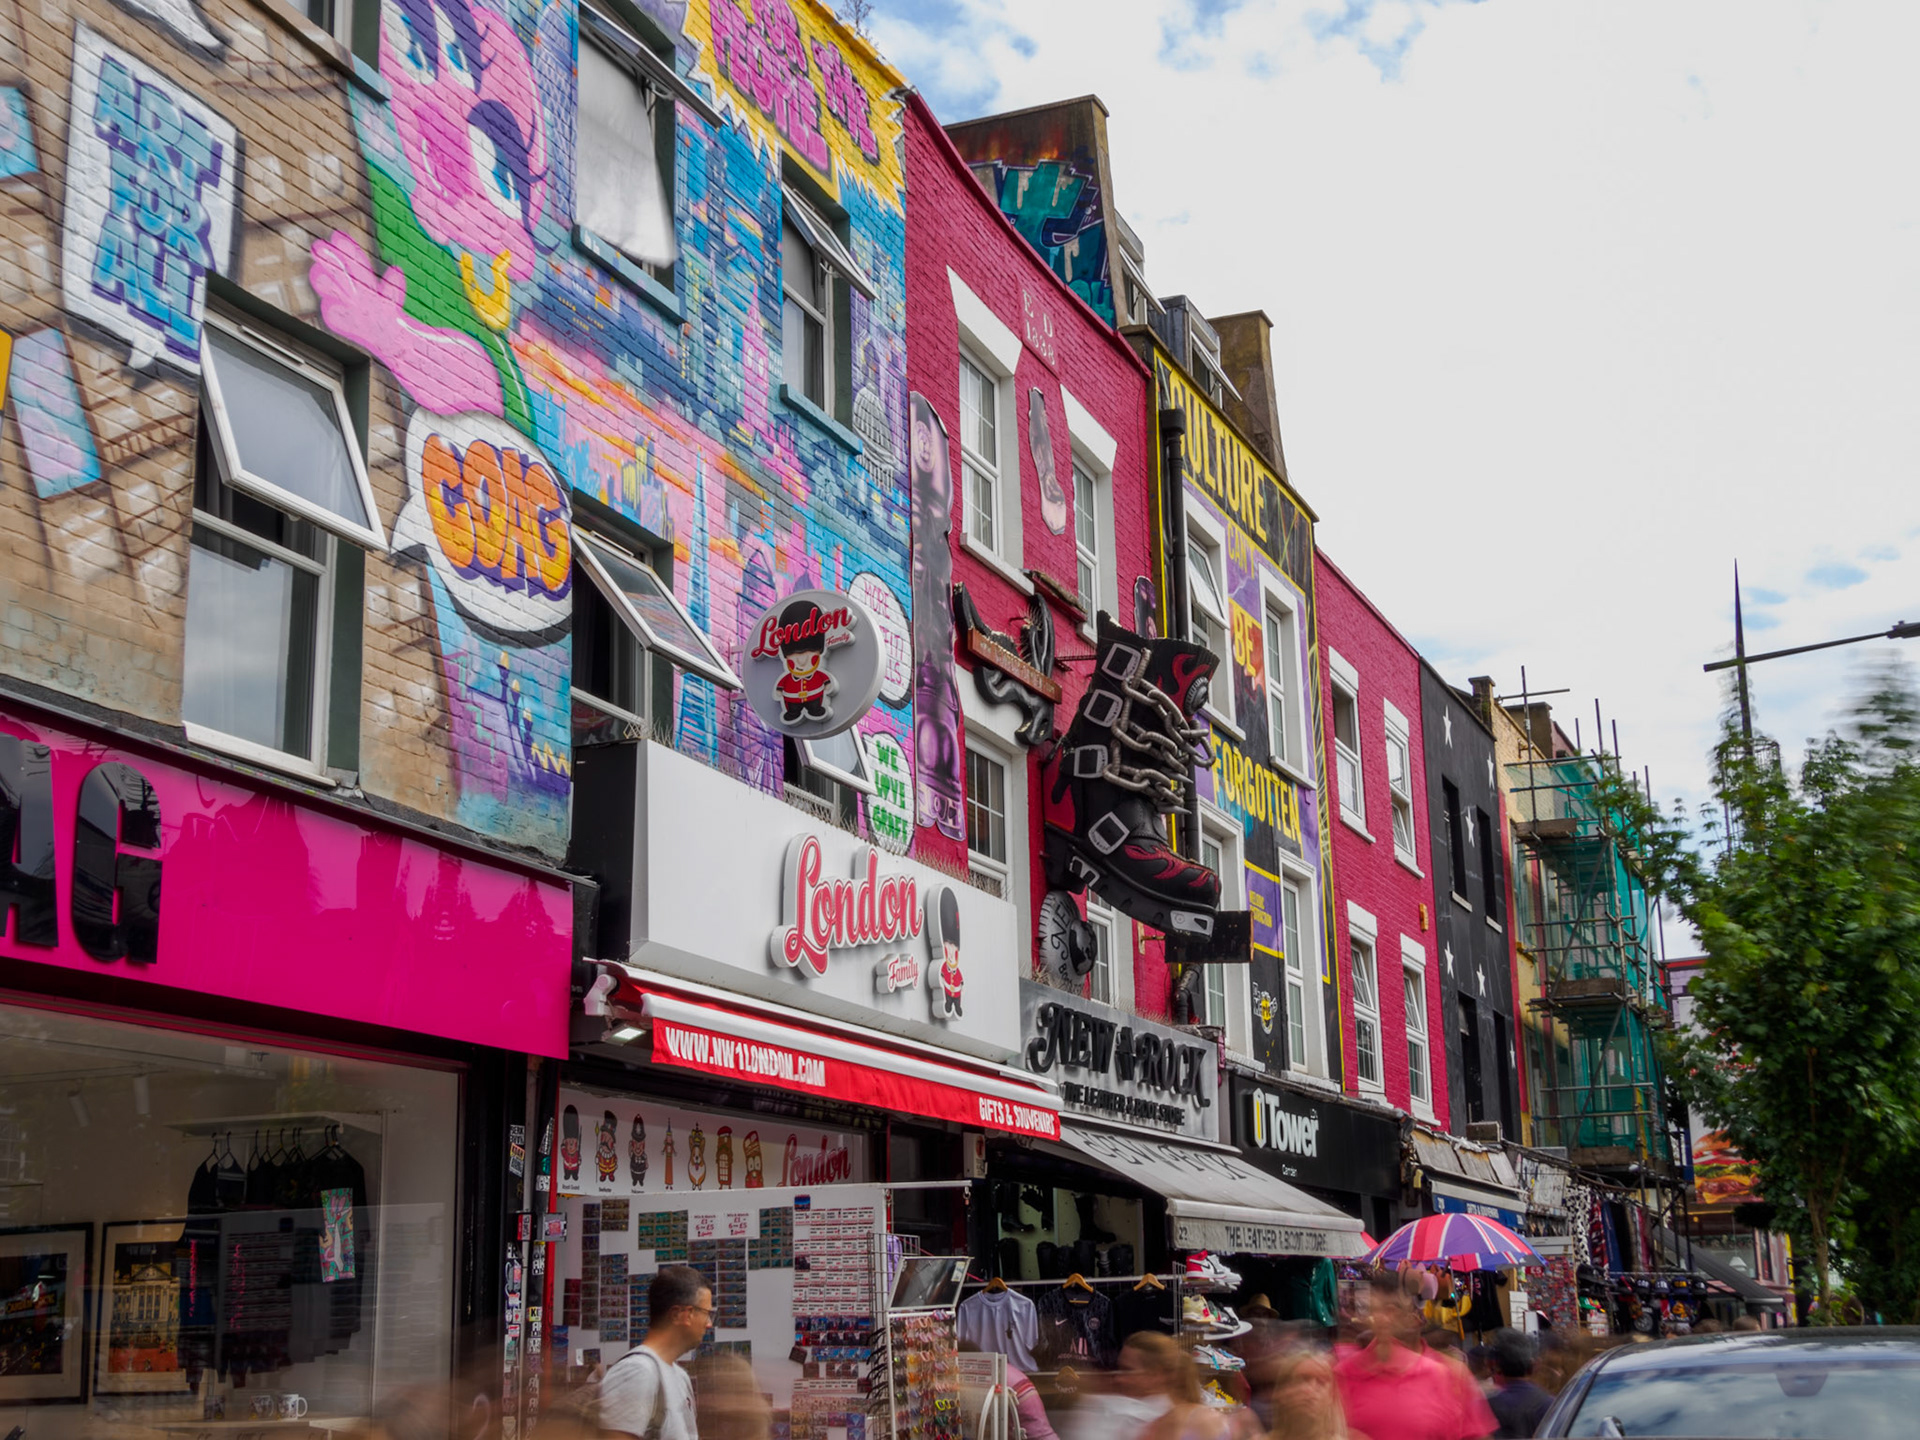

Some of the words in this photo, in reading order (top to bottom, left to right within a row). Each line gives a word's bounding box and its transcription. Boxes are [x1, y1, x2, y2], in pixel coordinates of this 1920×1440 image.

[95, 52, 222, 200] ART
[811, 36, 879, 164] THE
[110, 147, 216, 269] FOR
[91, 214, 205, 362] ALL
[1170, 368, 1268, 543] CULTURE
[751, 606, 852, 658] London
[825, 632, 851, 647] Family
[1231, 604, 1257, 677] BE
[874, 769, 906, 809] LOVE
[876, 739, 899, 773] WE
[1211, 731, 1303, 846] FORGOTTEN
[783, 834, 923, 975] London
[887, 954, 919, 992] Family
[1028, 1002, 1117, 1074] NEW
[1135, 1031, 1211, 1108] ROCK
[979, 1097, 1004, 1124] GIFTS
[1005, 1107, 1013, 1126] &
[1015, 1108, 1056, 1136] SOUVENIRS
[1064, 1081, 1083, 1103] THE
[1084, 1086, 1126, 1112] LEATHER
[1265, 1092, 1319, 1158] Tower
[776, 1133, 852, 1188] London
[1225, 1226, 1242, 1248] THE
[1243, 1228, 1277, 1249] LEATHER
